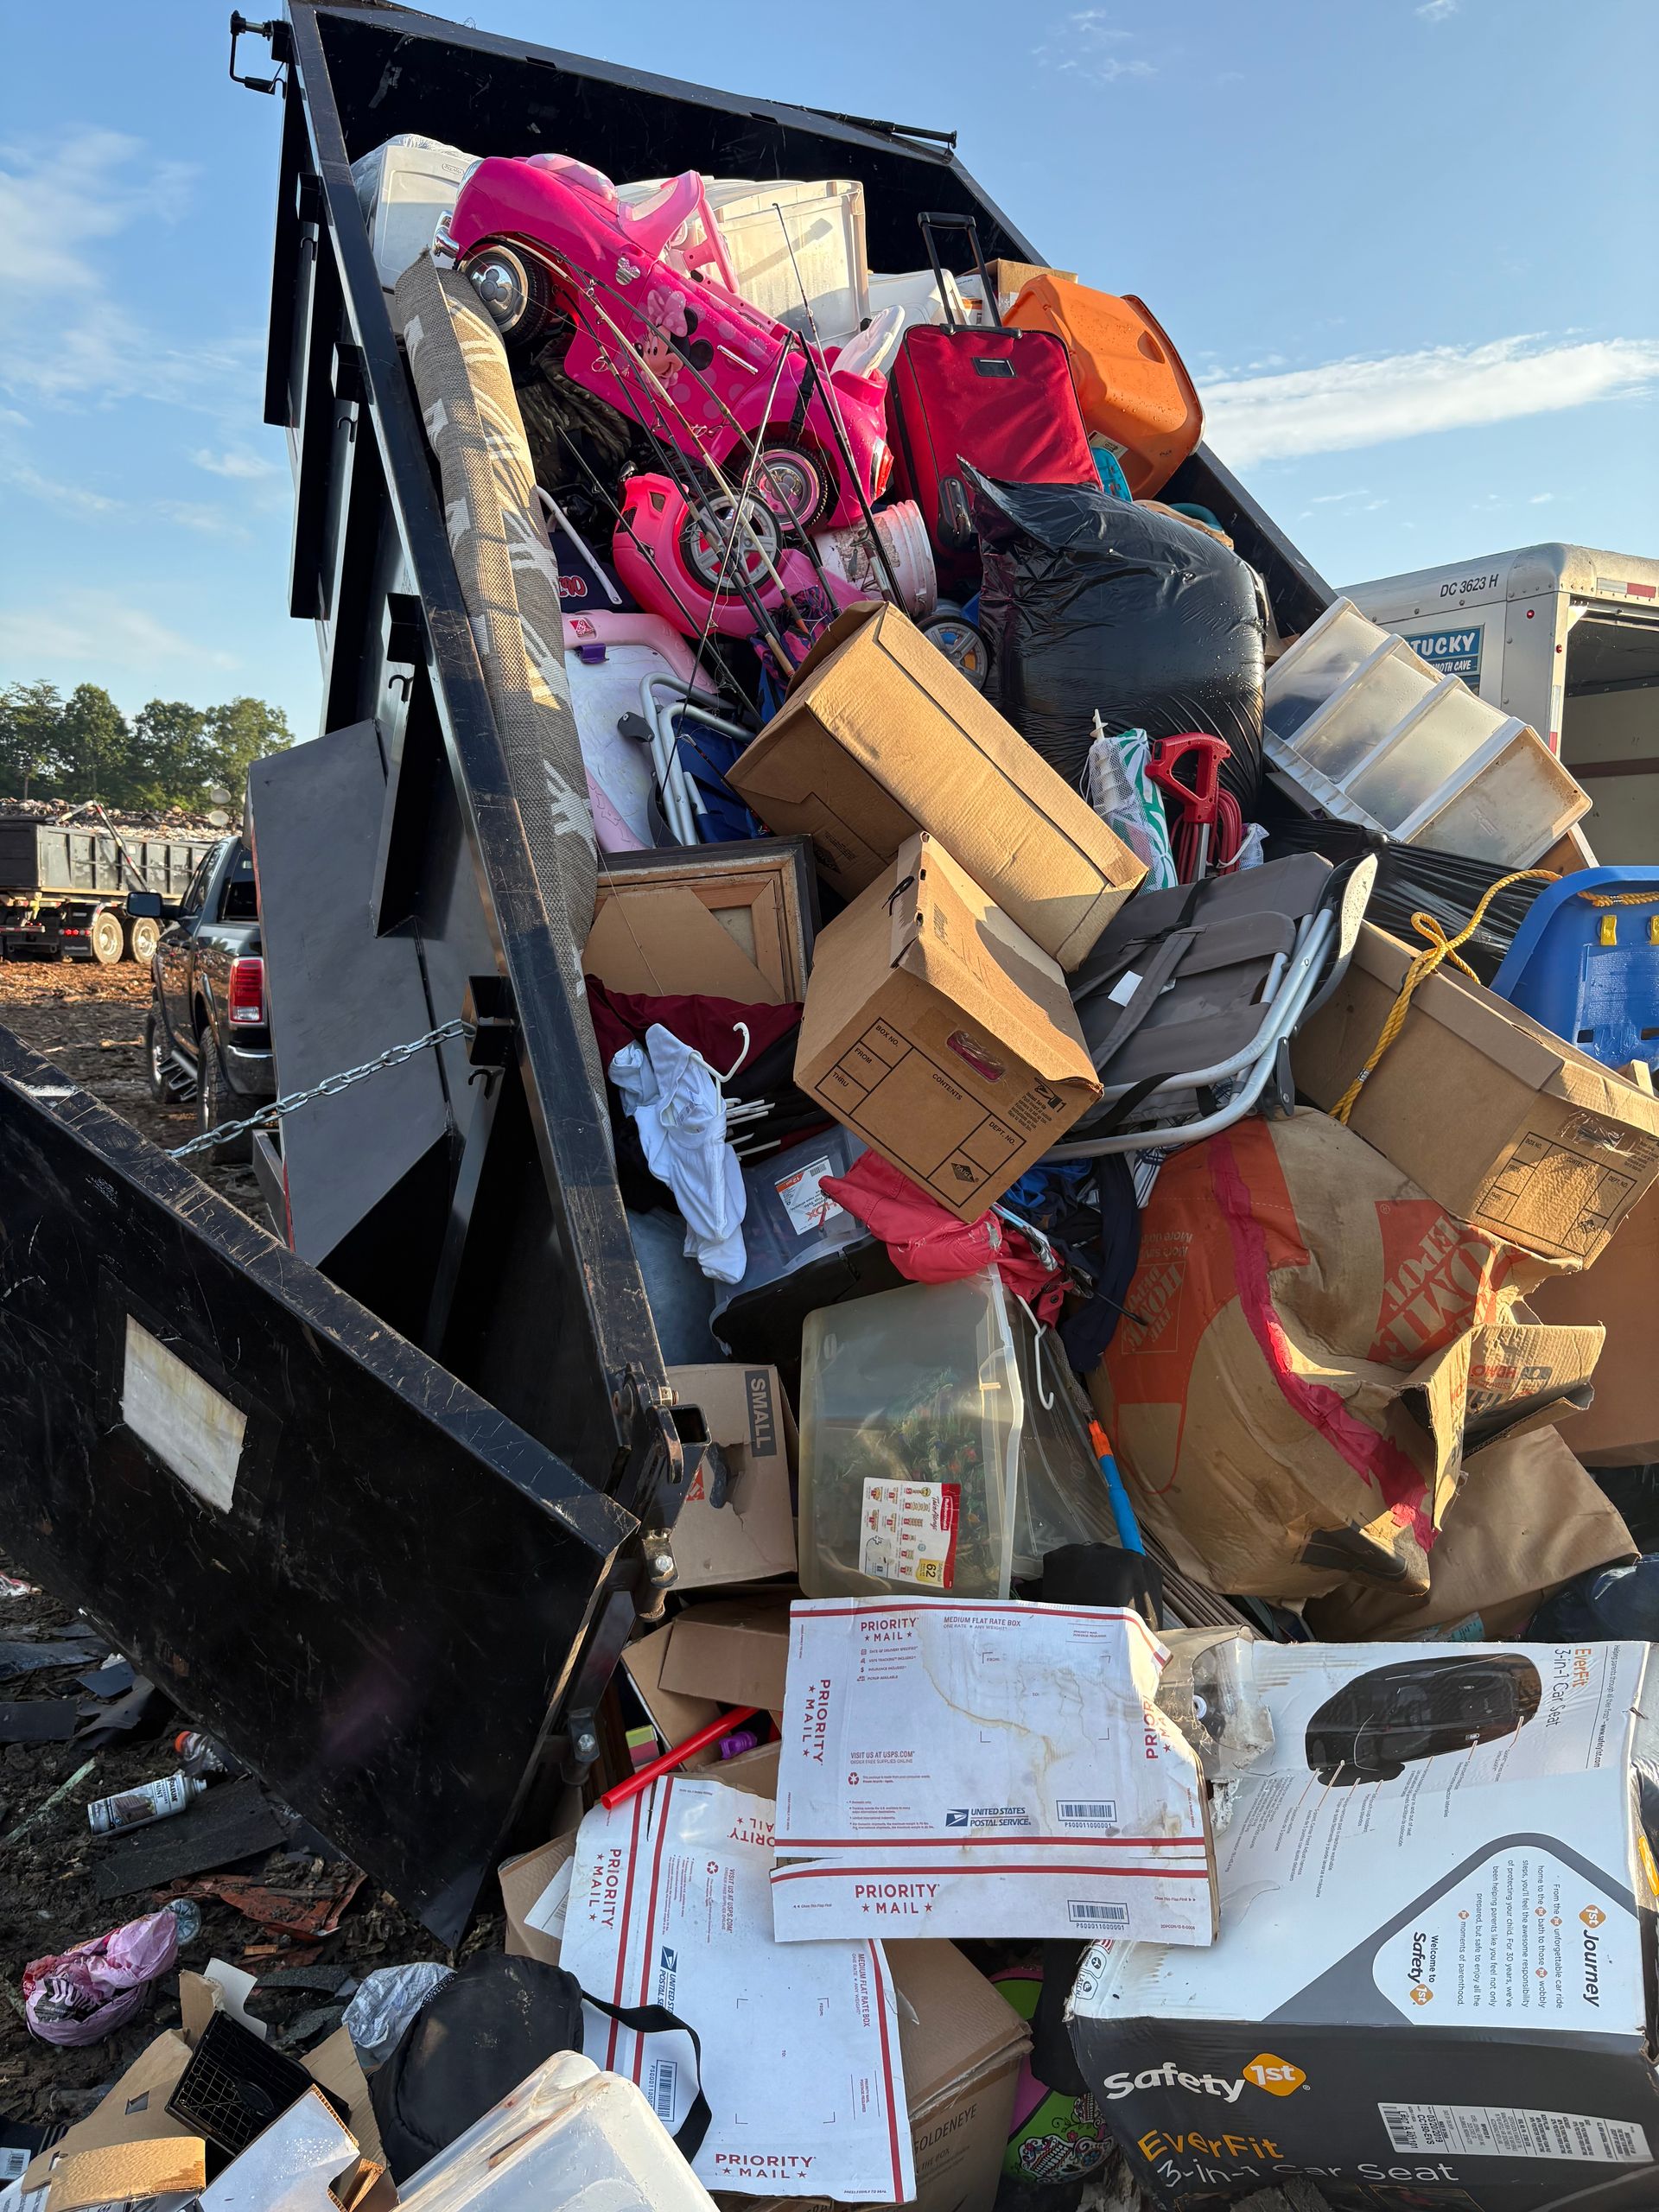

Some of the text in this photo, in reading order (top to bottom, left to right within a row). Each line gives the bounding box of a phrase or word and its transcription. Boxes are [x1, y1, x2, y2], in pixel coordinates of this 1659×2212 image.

[1440, 574, 1499, 597] DC 3623 H
[1408, 632, 1476, 656] TUCKY
[1454, 659, 1472, 671] CAVE
[875, 1024, 898, 1046] BOX NO.
[854, 1047, 872, 1064] FROM
[830, 1071, 849, 1086] THRU
[931, 1073, 963, 1100] CONTENTS
[988, 1121, 1015, 1146] DEPT. NO.
[1382, 1216, 1461, 1311] EPOT
[750, 1376, 772, 1449] SMALL
[942, 1497, 950, 1530] Rubbermaid
[925, 1563, 937, 1578] 62
[861, 1618, 917, 1631] PRIORITY
[944, 1616, 970, 1625] MEDIUM
[971, 1617, 988, 1626] FLAT
[988, 1618, 1006, 1626] RATE
[874, 1631, 902, 1642] MAIL
[1572, 1648, 1591, 1687] EverFit
[1545, 1649, 1571, 1727] 3-in-1 Car Seat
[802, 1699, 815, 1742] MAIL
[812, 1679, 830, 1764] PRIORITY
[750, 1817, 774, 1832] AIL
[969, 1818, 997, 1827] POSTAL
[729, 1827, 775, 1847] ORITY
[588, 1866, 603, 1906] MAIL
[601, 1848, 620, 1927] PRIORITY
[728, 1885, 734, 1893] US
[855, 1884, 938, 1898] PRIORITY
[1490, 1882, 1498, 1905] helping
[1505, 1867, 1514, 1900] protecting
[875, 1902, 918, 1913] MAIL
[1407, 1931, 1426, 1983] Safety
[1428, 1935, 1438, 1982] Welcome to
[1506, 1952, 1513, 1961] 30
[1553, 1928, 1562, 1978] unforgettable
[1582, 1908, 1599, 2007] 1st Journey
[658, 1969, 666, 1996] POSTAL
[1472, 1963, 1481, 1982] enjoy
[1521, 1959, 1529, 2007] responsibility
[859, 1980, 868, 1994] FLAT
[1488, 1991, 1497, 2006] only
[1537, 1980, 1547, 2008] wobbly
[861, 1995, 869, 2012] RATE
[1472, 1994, 1481, 2006] the
[1555, 1993, 1564, 2008] ride
[648, 2064, 657, 2107] PS00011000
[1103, 2062, 1296, 2103] Safety 1st
[1137, 2129, 1285, 2162] EverFit
[715, 2153, 813, 2168] PRIORITY
[739, 2167, 790, 2178] MAIL
[1156, 2158, 1459, 2188] 3-in-1 Car Seat
